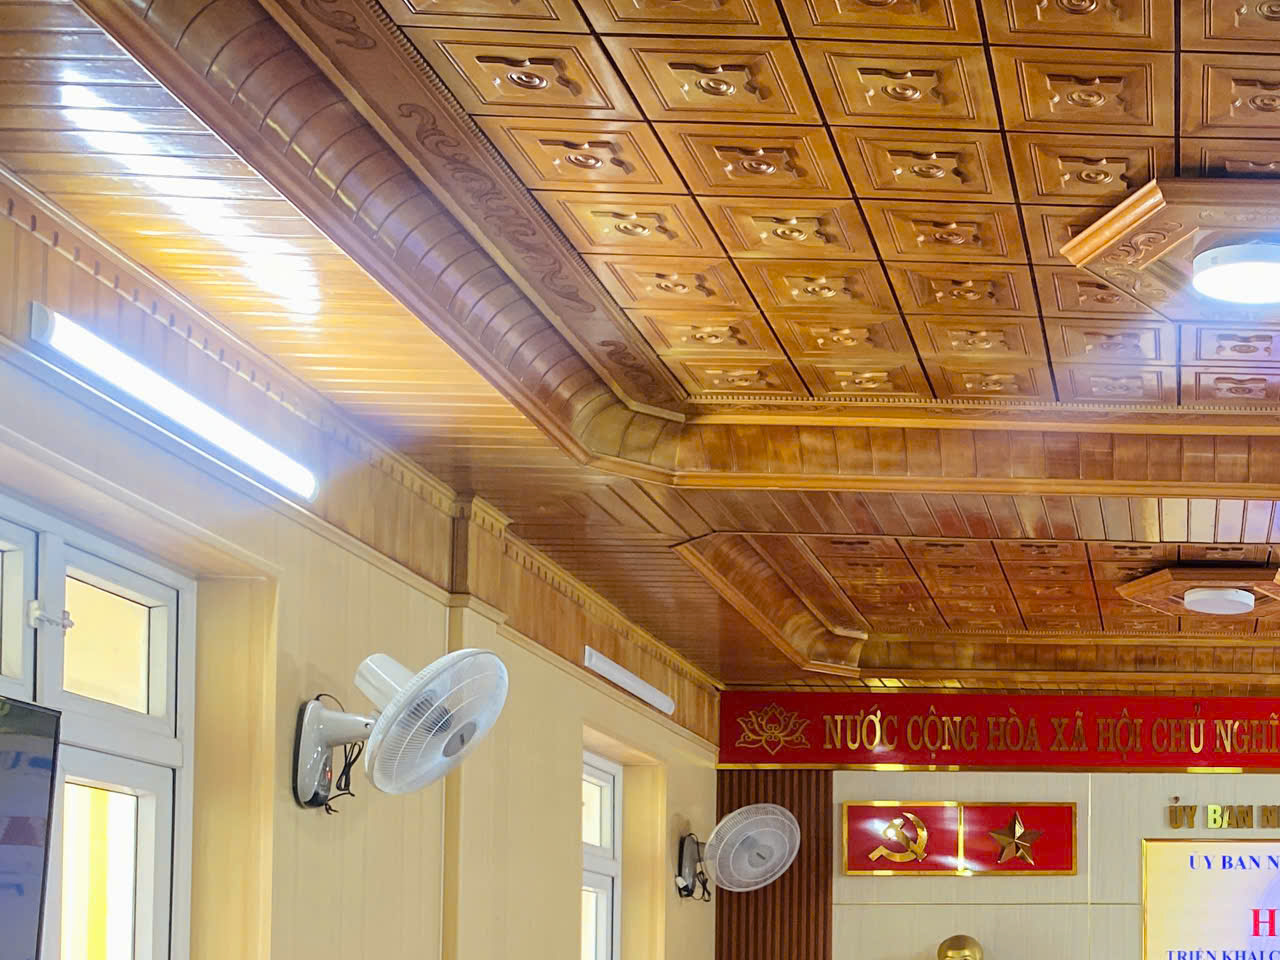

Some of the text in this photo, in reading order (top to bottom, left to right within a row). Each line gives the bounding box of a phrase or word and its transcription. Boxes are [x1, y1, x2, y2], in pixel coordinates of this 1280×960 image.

[823, 704, 898, 750] NƯỚC
[907, 704, 979, 759] CỘNG
[987, 706, 1040, 752] HÒA
[1050, 707, 1087, 752] XÃ
[1096, 708, 1144, 760] HỘI
[1152, 704, 1205, 753] CHỦ
[1168, 796, 1198, 829] ỦY
[1206, 803, 1254, 829] BAN
[1221, 855, 1261, 870] BAN
